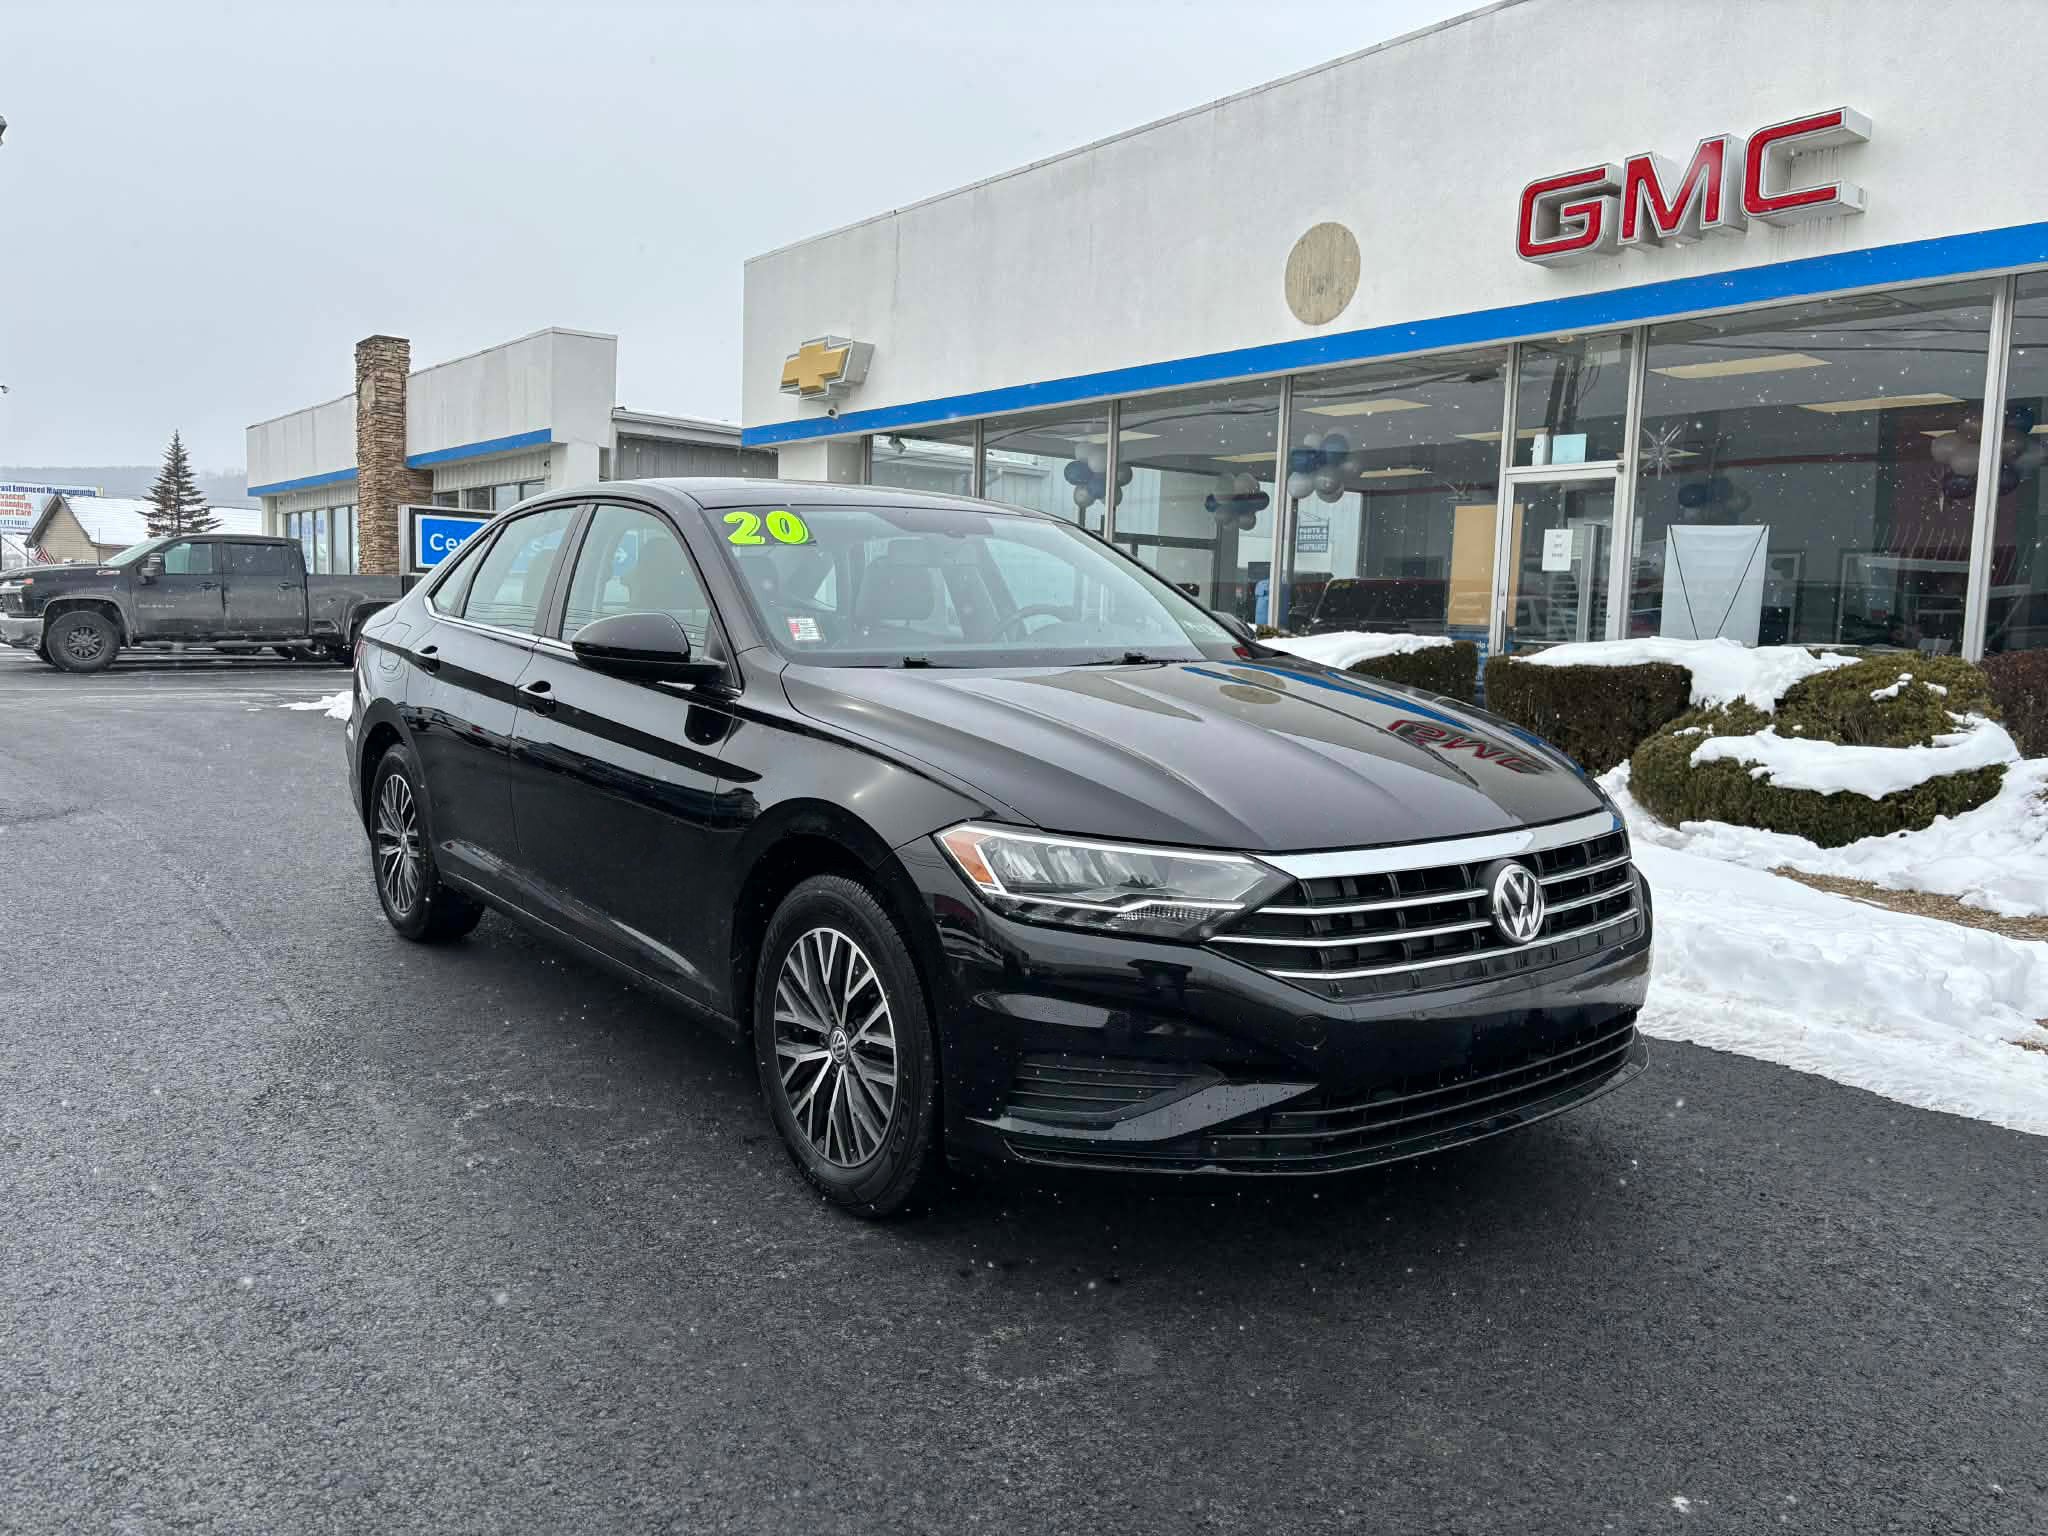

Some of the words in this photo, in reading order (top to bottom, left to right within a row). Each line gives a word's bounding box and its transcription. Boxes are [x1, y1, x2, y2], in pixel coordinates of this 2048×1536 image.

[1516, 106, 1866, 264] GMC
[429, 533, 467, 552] Ce
[723, 511, 809, 544] 20
